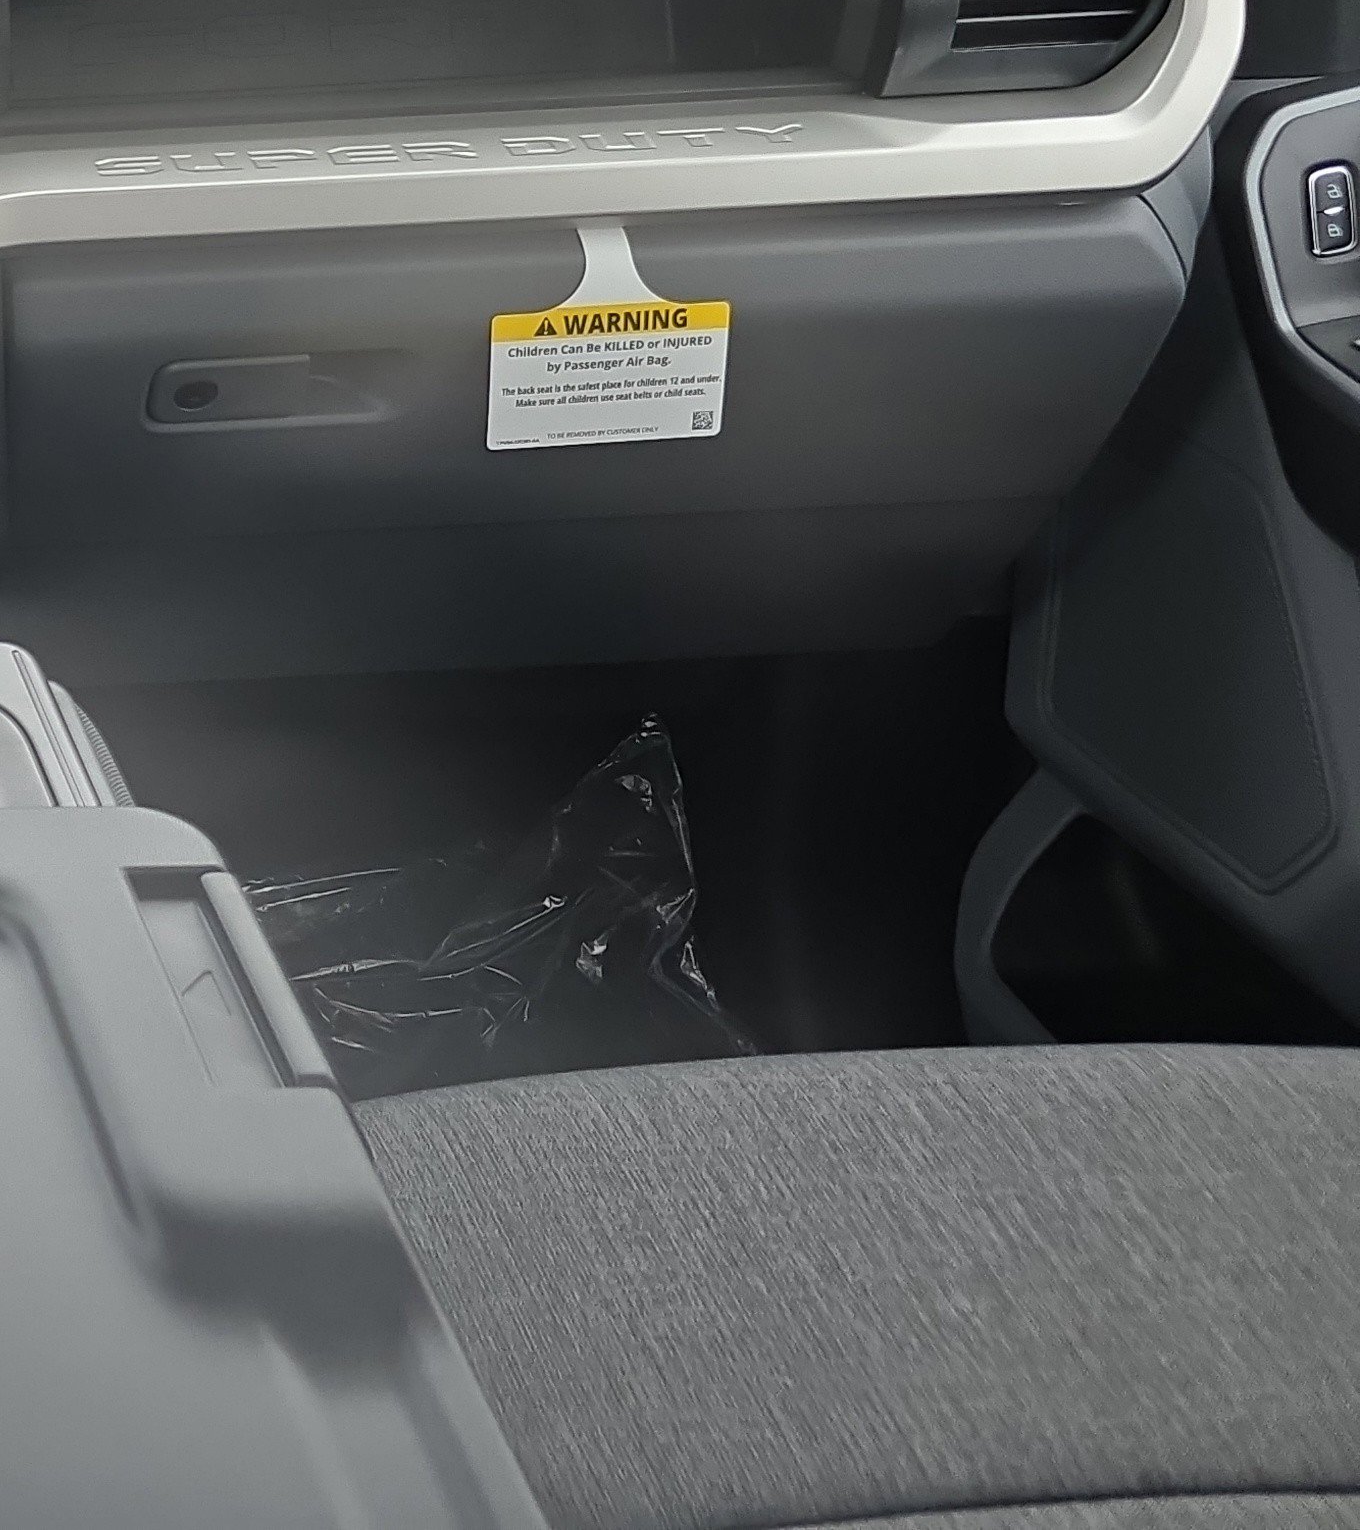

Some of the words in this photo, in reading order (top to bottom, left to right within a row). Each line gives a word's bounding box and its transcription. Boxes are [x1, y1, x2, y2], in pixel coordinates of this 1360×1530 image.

[94, 139, 479, 177] SUPER
[502, 123, 805, 159] DUTY
[563, 307, 688, 336] WARNING
[508, 344, 558, 358] Children
[561, 343, 583, 355] Can
[586, 342, 601, 353] Be
[604, 340, 644, 352] KILLED
[647, 341, 661, 349] or
[663, 336, 712, 348] INJURED
[547, 361, 562, 374] by
[564, 358, 624, 373] Passenger
[626, 356, 644, 367] Air
[647, 355, 672, 368] Bag.
[502, 387, 515, 396] The
[517, 386, 535, 395] back
[537, 386, 553, 394] seat
[555, 384, 561, 393] is
[563, 383, 576, 392] the
[577, 381, 600, 391] safest
[602, 380, 622, 392] place
[624, 379, 636, 388] for
[637, 377, 667, 388] children
[670, 376, 679, 386] 12
[681, 375, 695, 384] and
[697, 373, 722, 384] under.
[515, 398, 536, 407] Make
[539, 398, 555, 406] sure
[556, 396, 567, 405] all
[568, 394, 599, 404] children
[601, 394, 613, 402] use
[615, 392, 632, 401] seat
[633, 390, 652, 400] belts
[654, 391, 662, 399] or
[664, 388, 682, 398] child
[684, 387, 706, 397] seats.
[566, 430, 596, 439] REMOVED
[606, 427, 641, 437] CUSTOMER
[641, 426, 659, 434] ONLY
